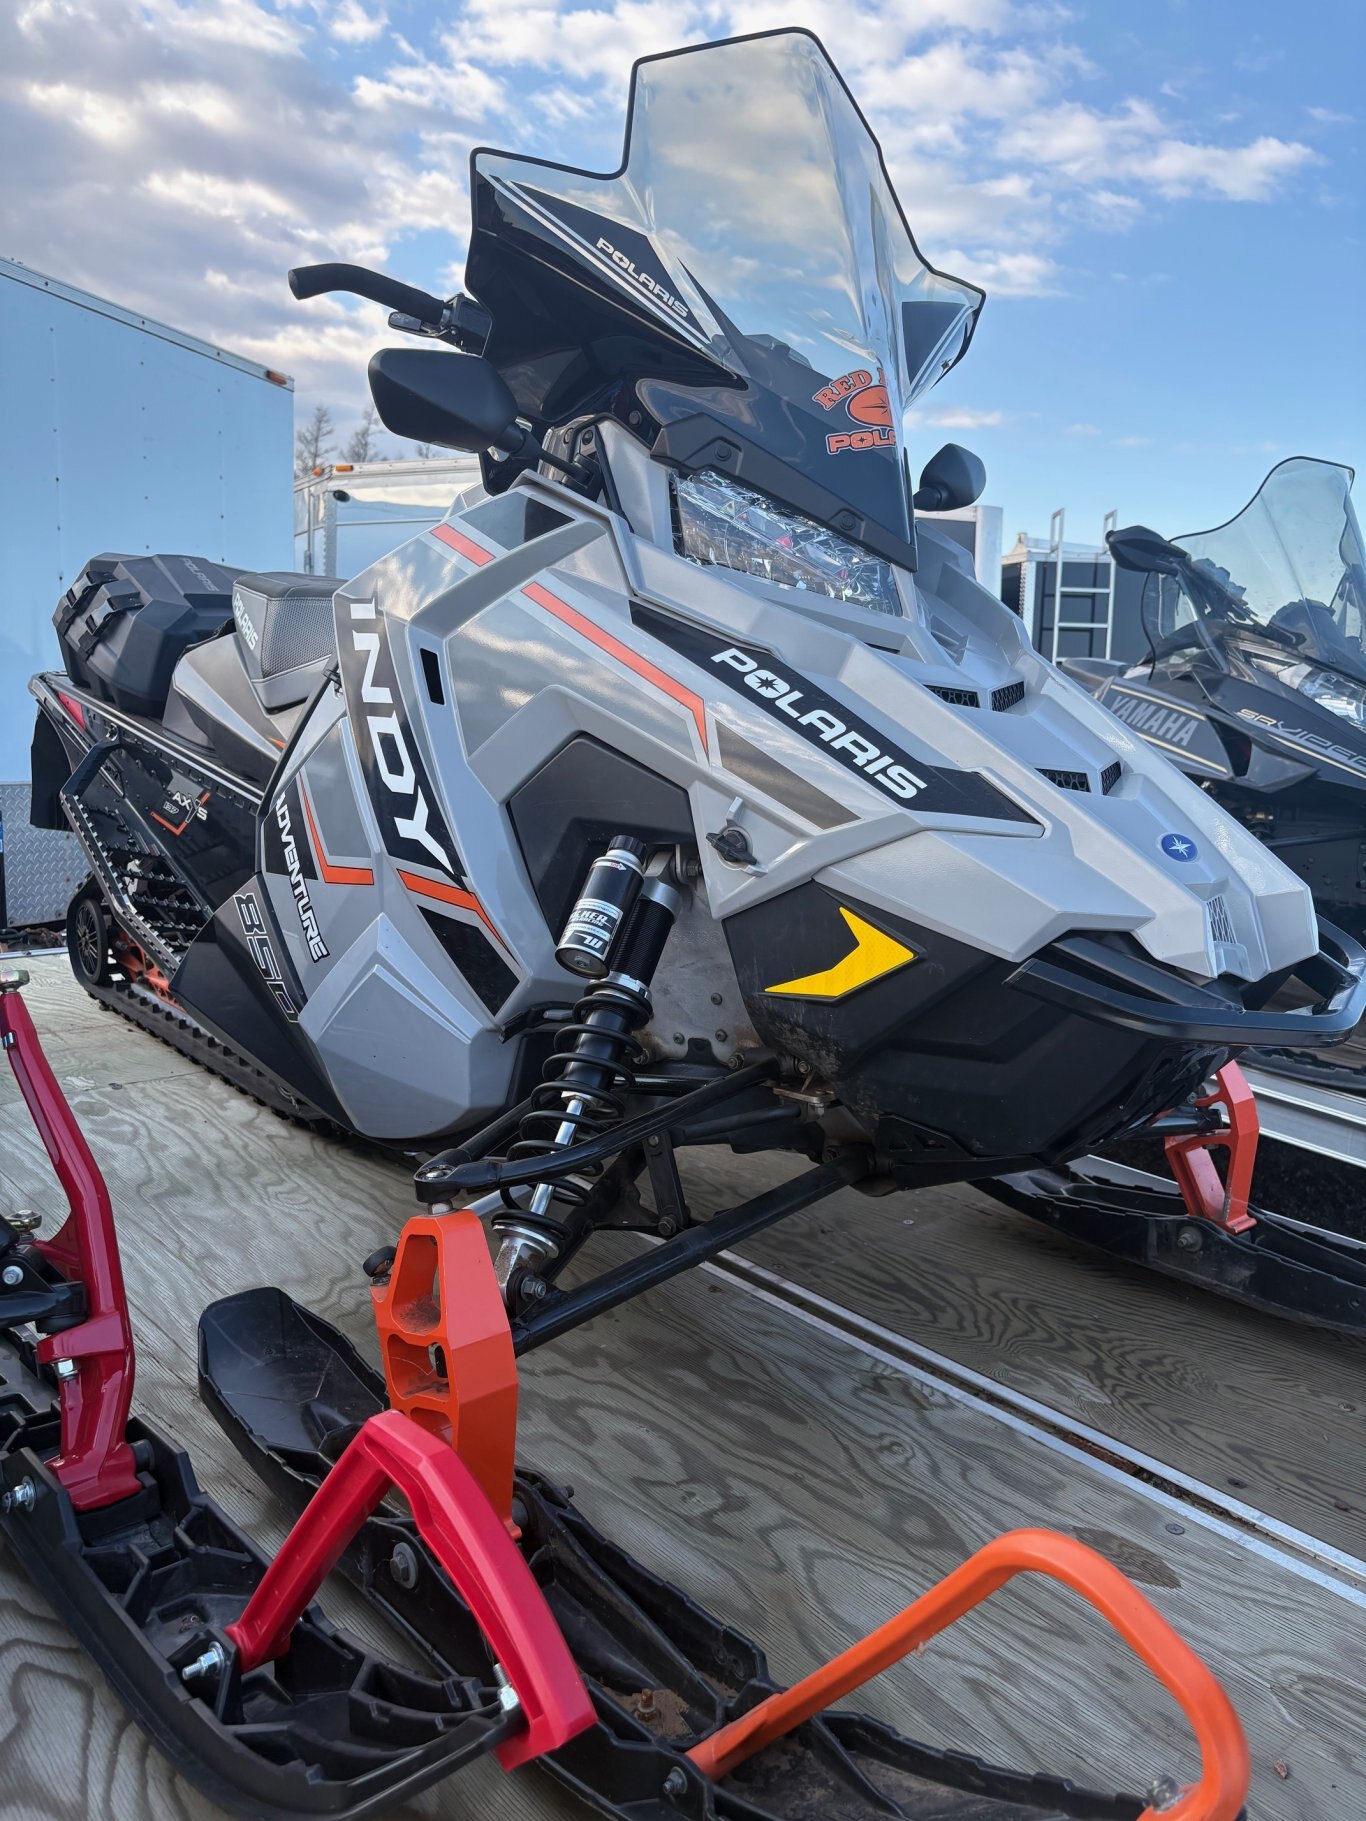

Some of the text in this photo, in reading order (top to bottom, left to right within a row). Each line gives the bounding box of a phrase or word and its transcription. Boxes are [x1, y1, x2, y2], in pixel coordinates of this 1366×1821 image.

[596, 237, 689, 318] POLARIS
[812, 369, 873, 411] RED
[233, 592, 259, 650] POLARIS
[350, 597, 455, 876] INDY
[710, 647, 928, 799] POLARIS
[1110, 695, 1199, 747] YAMAHA
[275, 791, 330, 963] ADVENTURE
[233, 892, 300, 1023] 850
